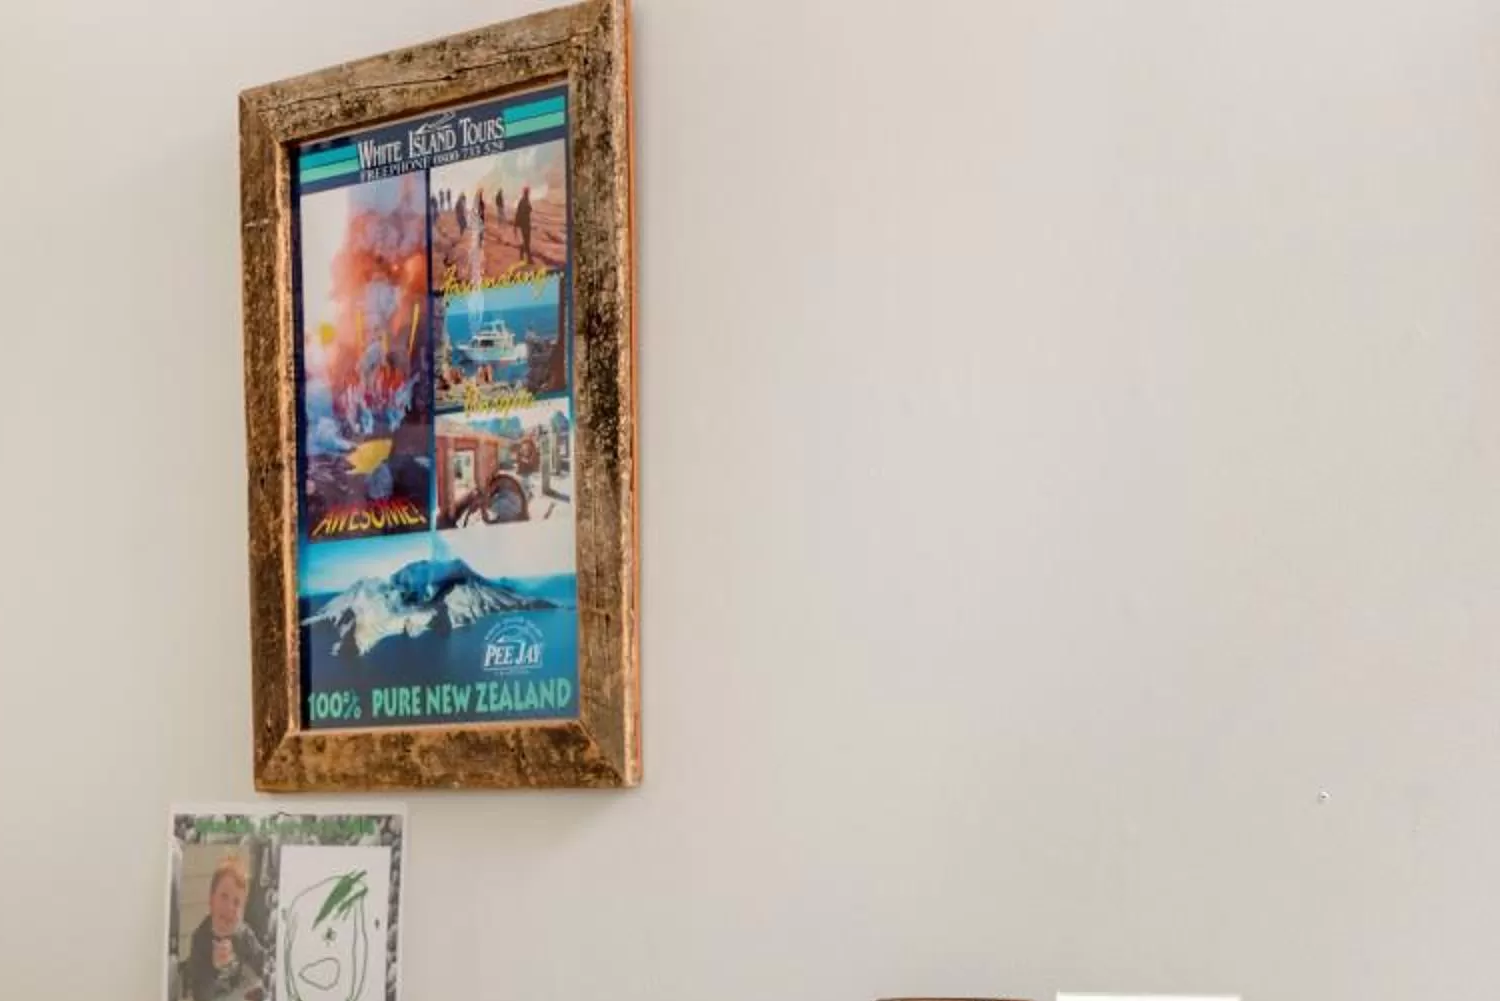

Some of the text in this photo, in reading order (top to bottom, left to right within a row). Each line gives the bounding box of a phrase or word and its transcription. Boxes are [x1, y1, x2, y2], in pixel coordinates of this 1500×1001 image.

[358, 140, 403, 168] WHITE
[408, 130, 458, 158] ISLAND
[460, 118, 504, 146] TOURS
[311, 502, 427, 537] AWESOME!
[483, 640, 542, 667] PEE JAY
[308, 677, 572, 720] 100% PURE NEW ZEALAND
